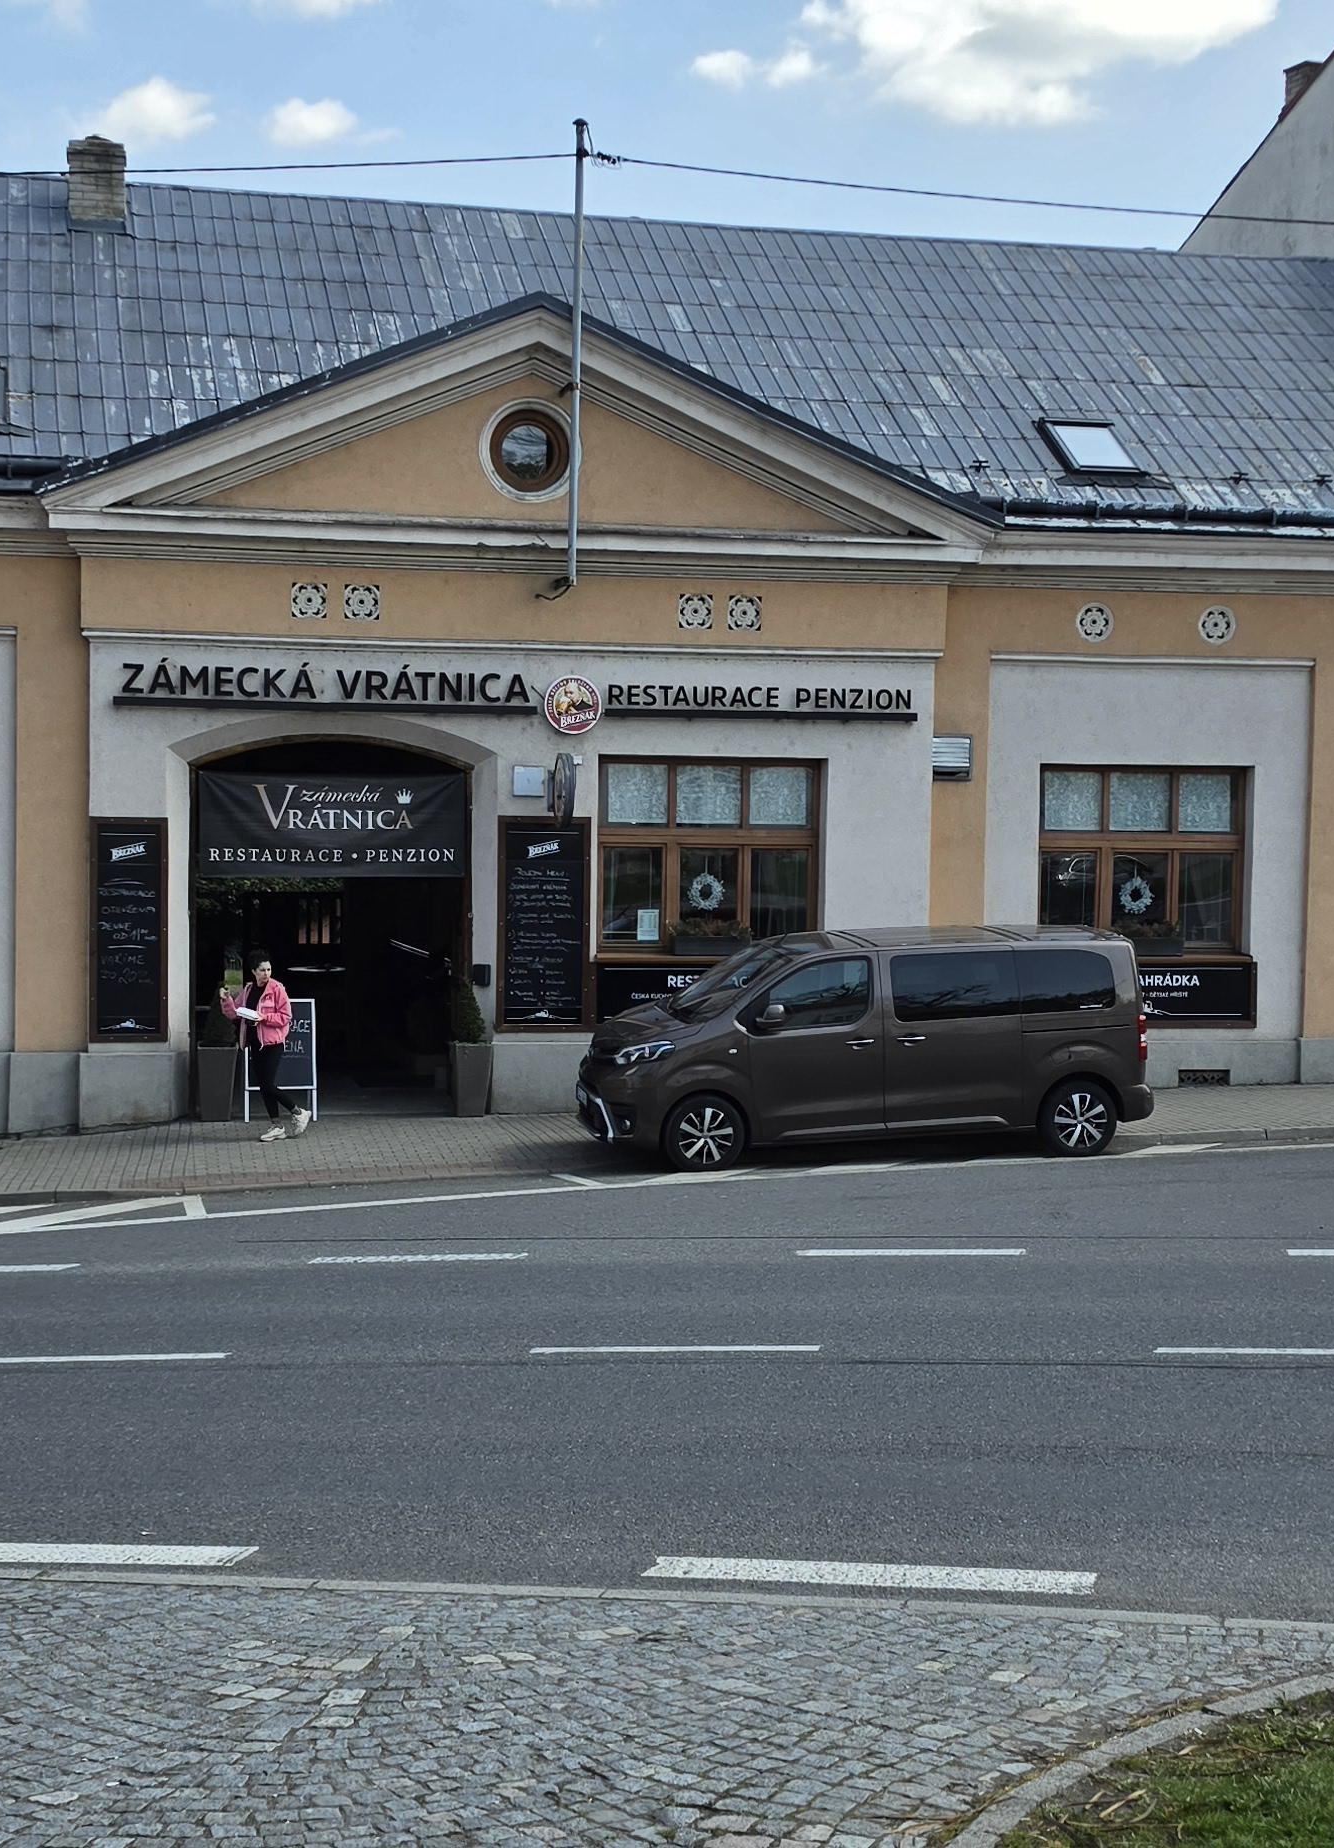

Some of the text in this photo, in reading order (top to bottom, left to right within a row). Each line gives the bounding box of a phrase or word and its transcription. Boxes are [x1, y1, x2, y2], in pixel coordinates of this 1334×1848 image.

[121, 657, 317, 699] ZÁMECKÁ
[336, 663, 531, 704] VRÁTNICA
[607, 684, 780, 708] RESTAURACE
[795, 687, 913, 711] PENZION
[299, 784, 385, 803] zámecká
[208, 848, 455, 863] RESTAURACE PENZION
[1139, 972, 1200, 987] AHRÁDKA
